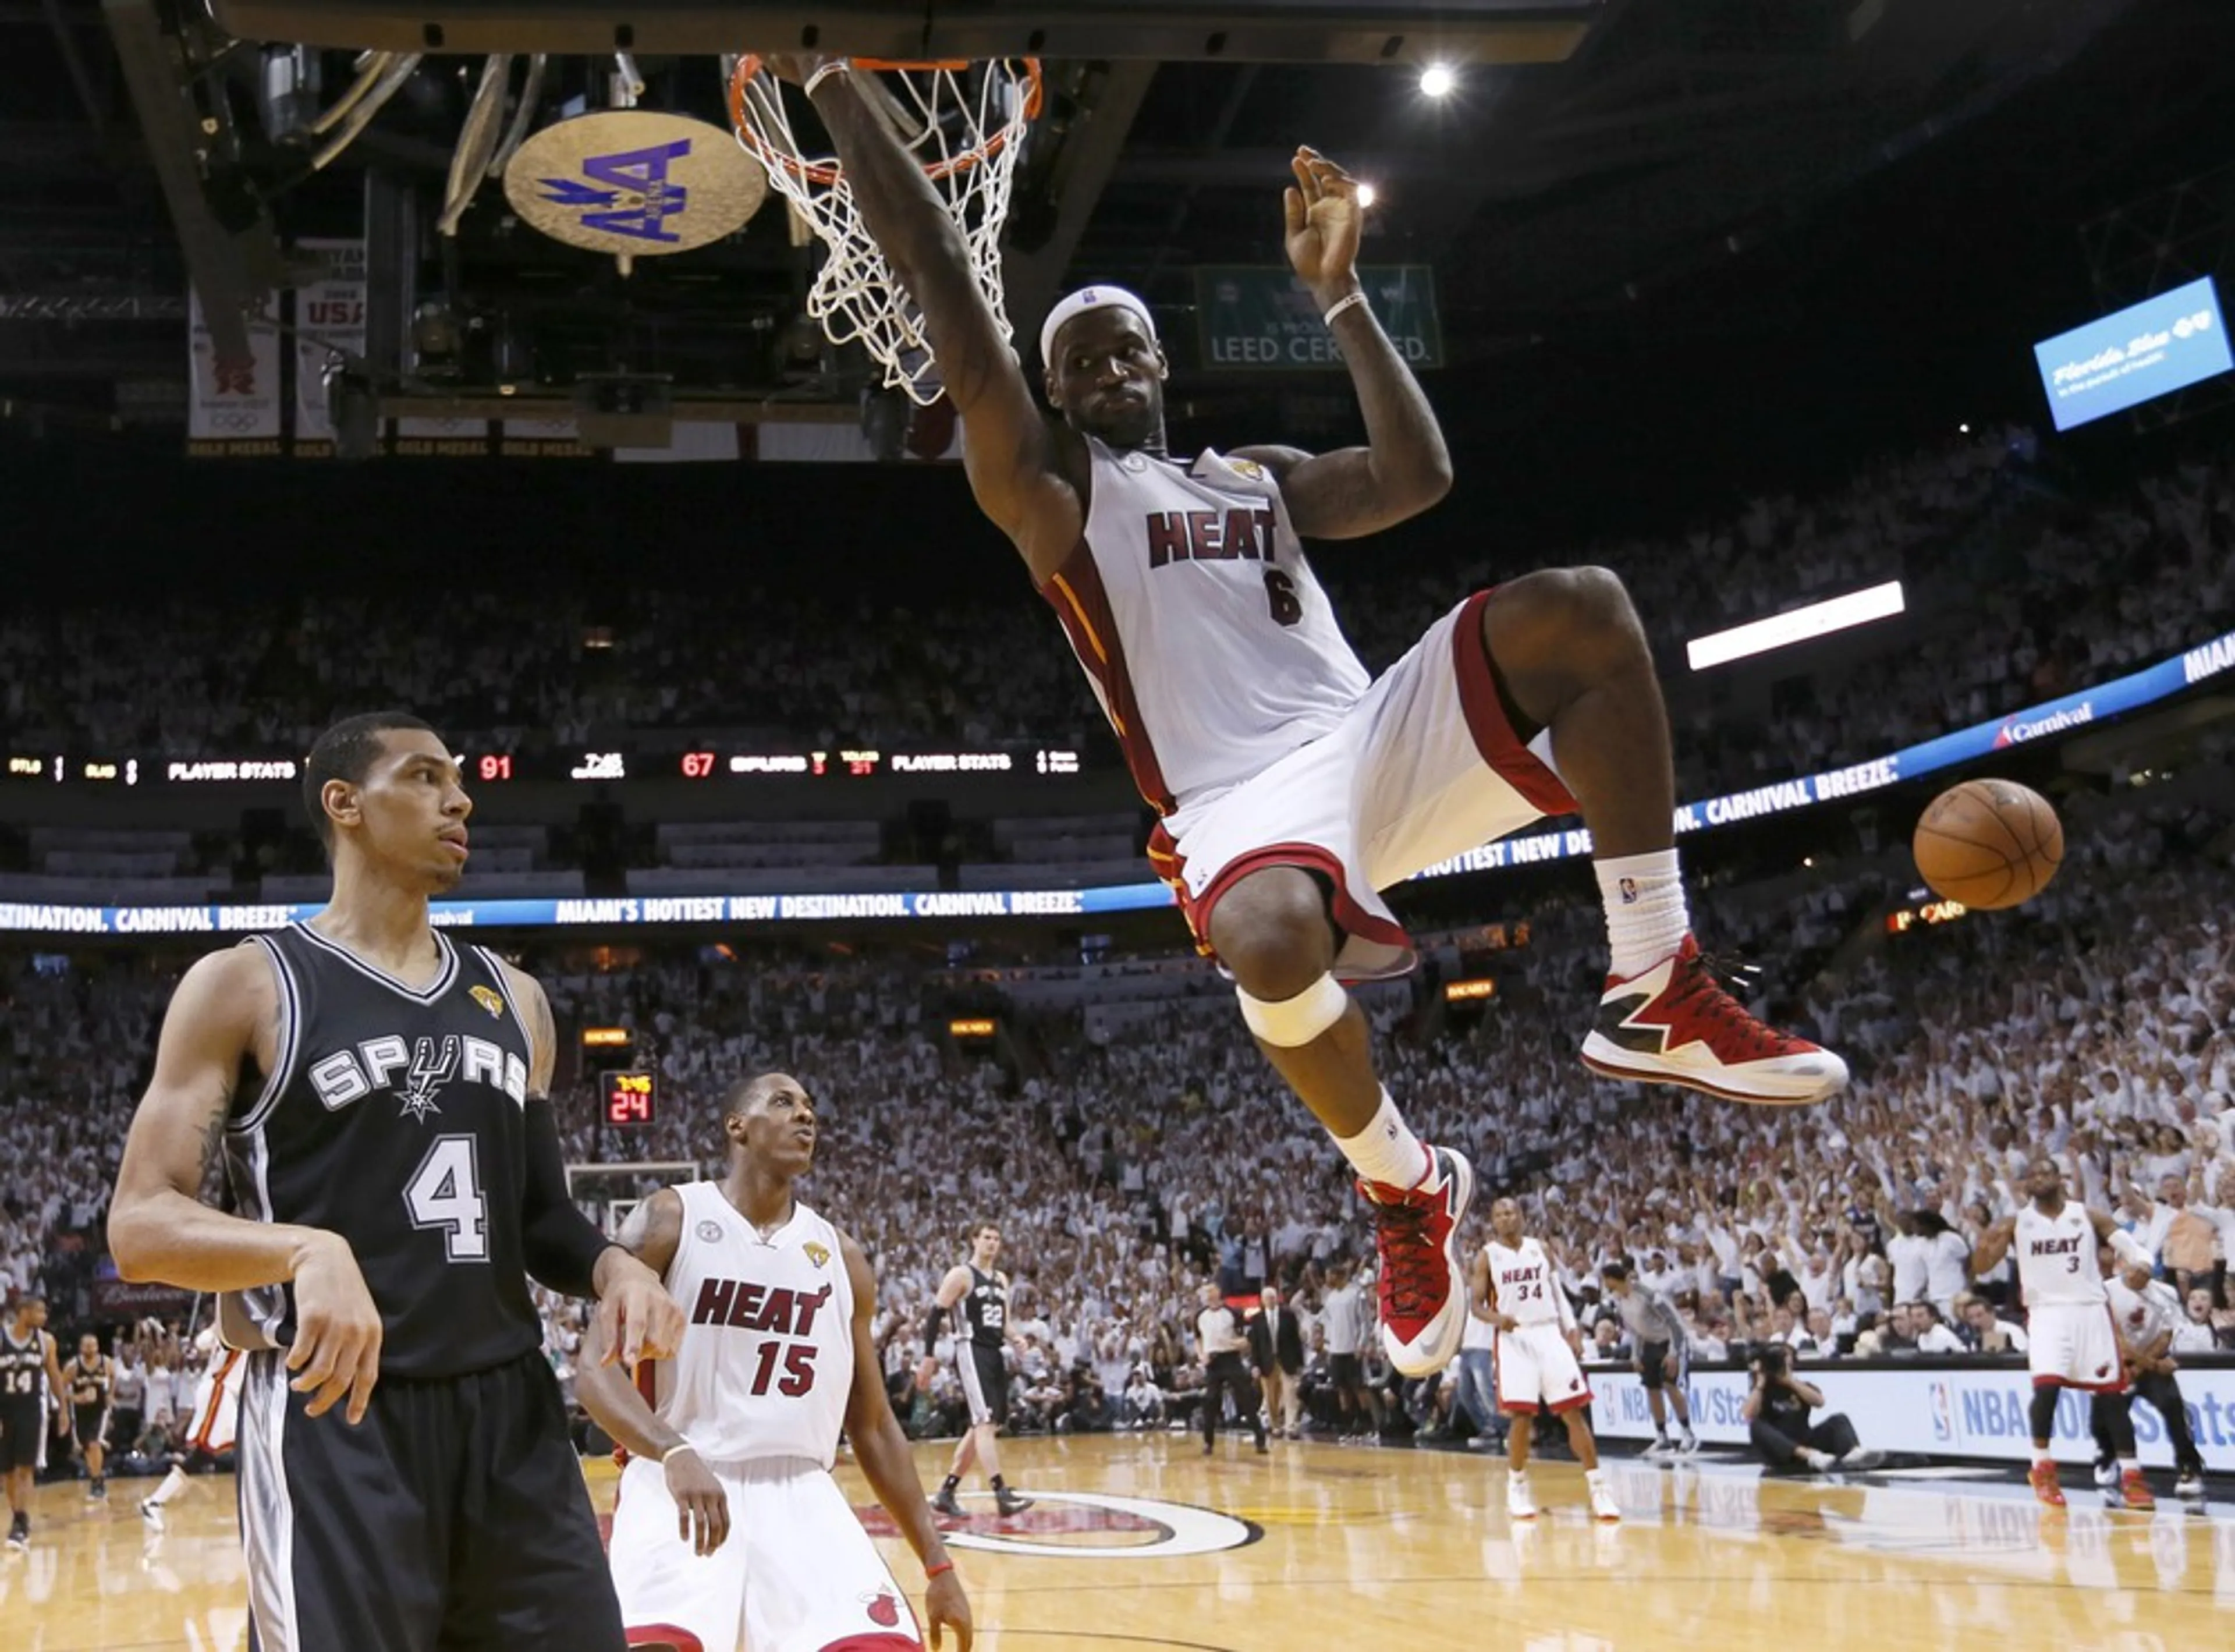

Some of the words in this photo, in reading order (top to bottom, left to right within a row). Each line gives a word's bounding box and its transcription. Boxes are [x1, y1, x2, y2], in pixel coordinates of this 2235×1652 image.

[1211, 336, 1279, 361] LEED
[1289, 336, 1432, 362] CERED.
[1146, 509, 1276, 569] HEAT
[1264, 569, 1303, 627] 6
[2013, 701, 2094, 743] Carnival
[169, 763, 236, 780] PLAYER
[239, 762, 296, 779] STATS
[480, 756, 512, 779] 91
[682, 753, 714, 776] 67
[892, 754, 956, 771] PLAYER
[958, 754, 1011, 770] STATS
[1706, 779, 1812, 825] CARNIVAL
[1511, 833, 1559, 864] NEW
[115, 907, 214, 932] CARNIVAL
[428, 908, 474, 926] rnival
[555, 898, 638, 924] MIAMI'S
[643, 897, 725, 922] HOTTEST
[730, 895, 776, 921] NEW
[781, 894, 909, 919] DESTINATION.
[914, 893, 1007, 916] CARNIVAL
[308, 1035, 527, 1125] SPURS
[612, 1092, 647, 1121] 24
[402, 1133, 491, 1263] 4
[2030, 1232, 2085, 1257] HEAT
[1502, 1263, 1543, 1285] HEAT
[2066, 1256, 2080, 1274] 3
[1517, 1283, 1543, 1302] 34
[691, 1279, 833, 1336] HEAT
[981, 1303, 1003, 1327] 22
[5, 1369, 33, 1394] 14
[751, 1341, 818, 1398] 15
